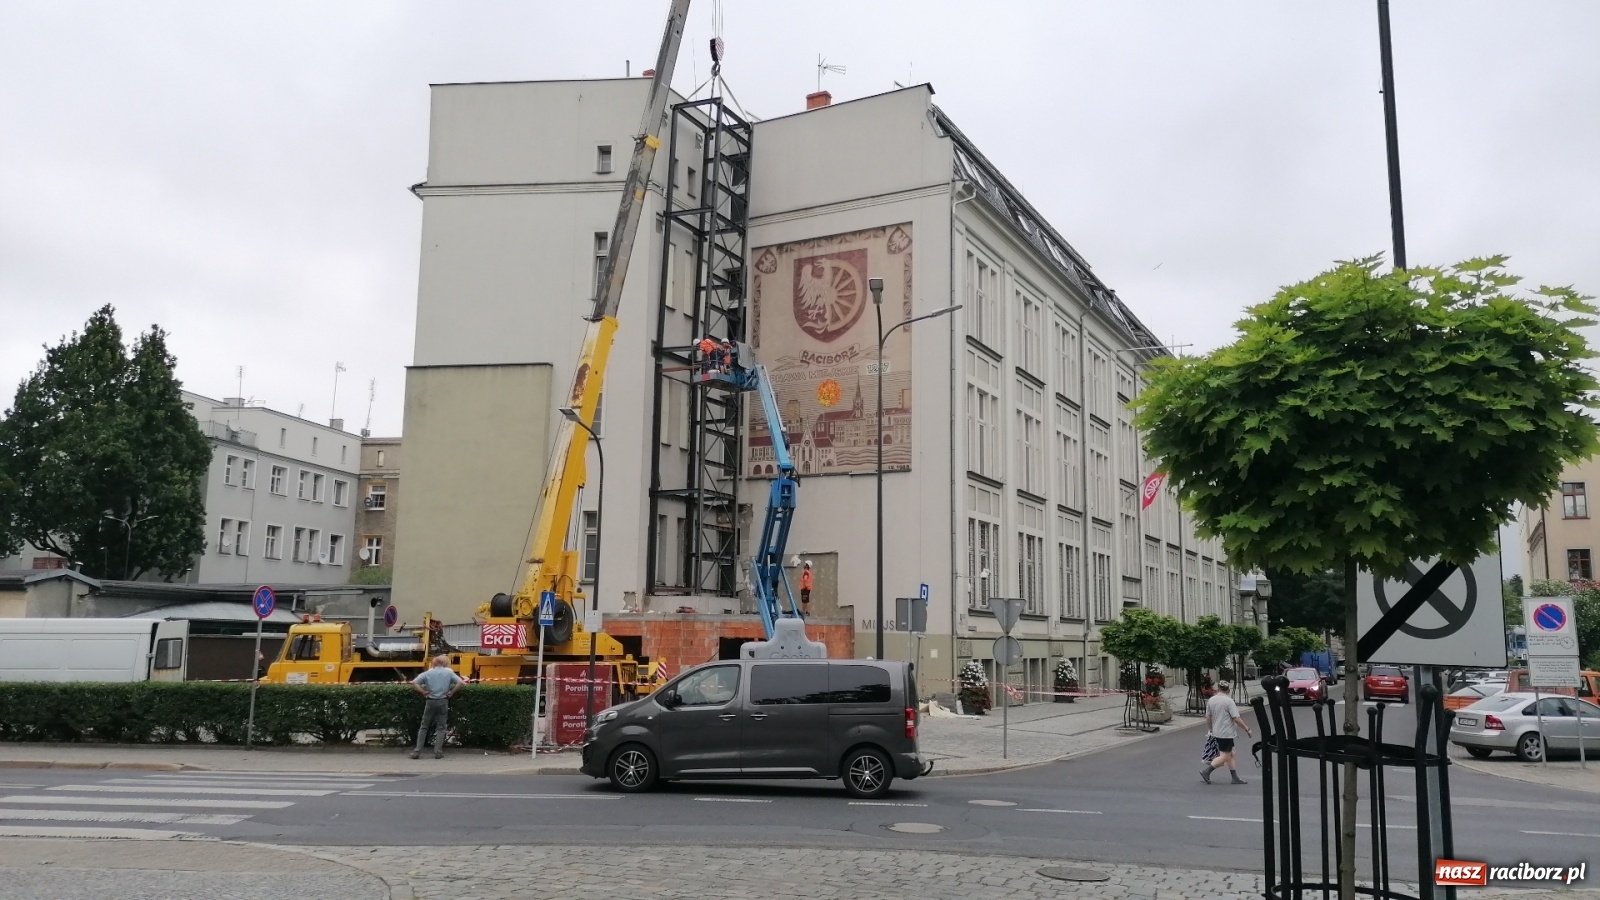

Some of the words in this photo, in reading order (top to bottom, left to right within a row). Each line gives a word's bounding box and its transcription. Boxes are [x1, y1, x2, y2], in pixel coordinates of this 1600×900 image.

[867, 362, 890, 374] 127
[861, 619, 895, 631] MIJS
[484, 634, 514, 645] CKD
[565, 684, 603, 692] Porothrm
